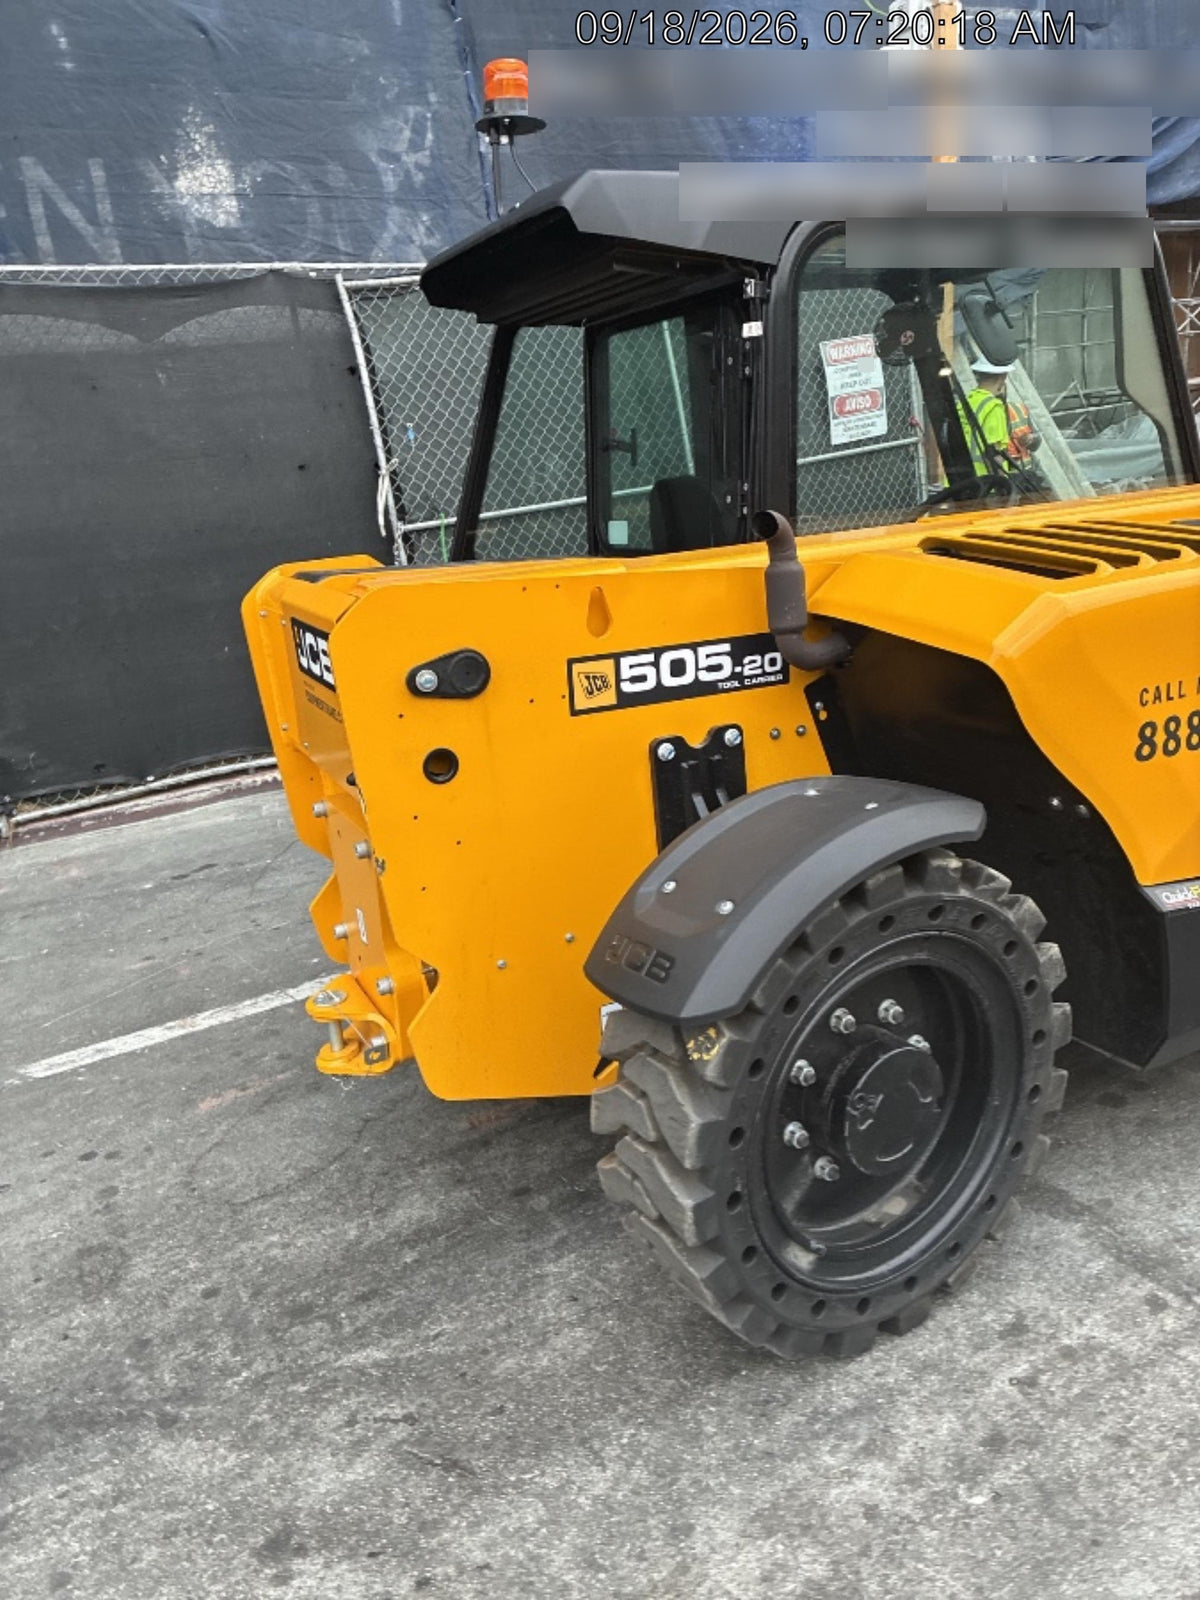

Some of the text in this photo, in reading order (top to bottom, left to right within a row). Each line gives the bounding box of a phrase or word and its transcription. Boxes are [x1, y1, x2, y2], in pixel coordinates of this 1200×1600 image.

[829, 341, 874, 361] WARNING
[844, 394, 872, 411] AVISO
[582, 673, 609, 697] JCB
[718, 673, 783, 690] TOOL CARRIER
[1139, 680, 1186, 707] CALL
[1134, 709, 1200, 762] 888
[605, 935, 676, 984] JCB
